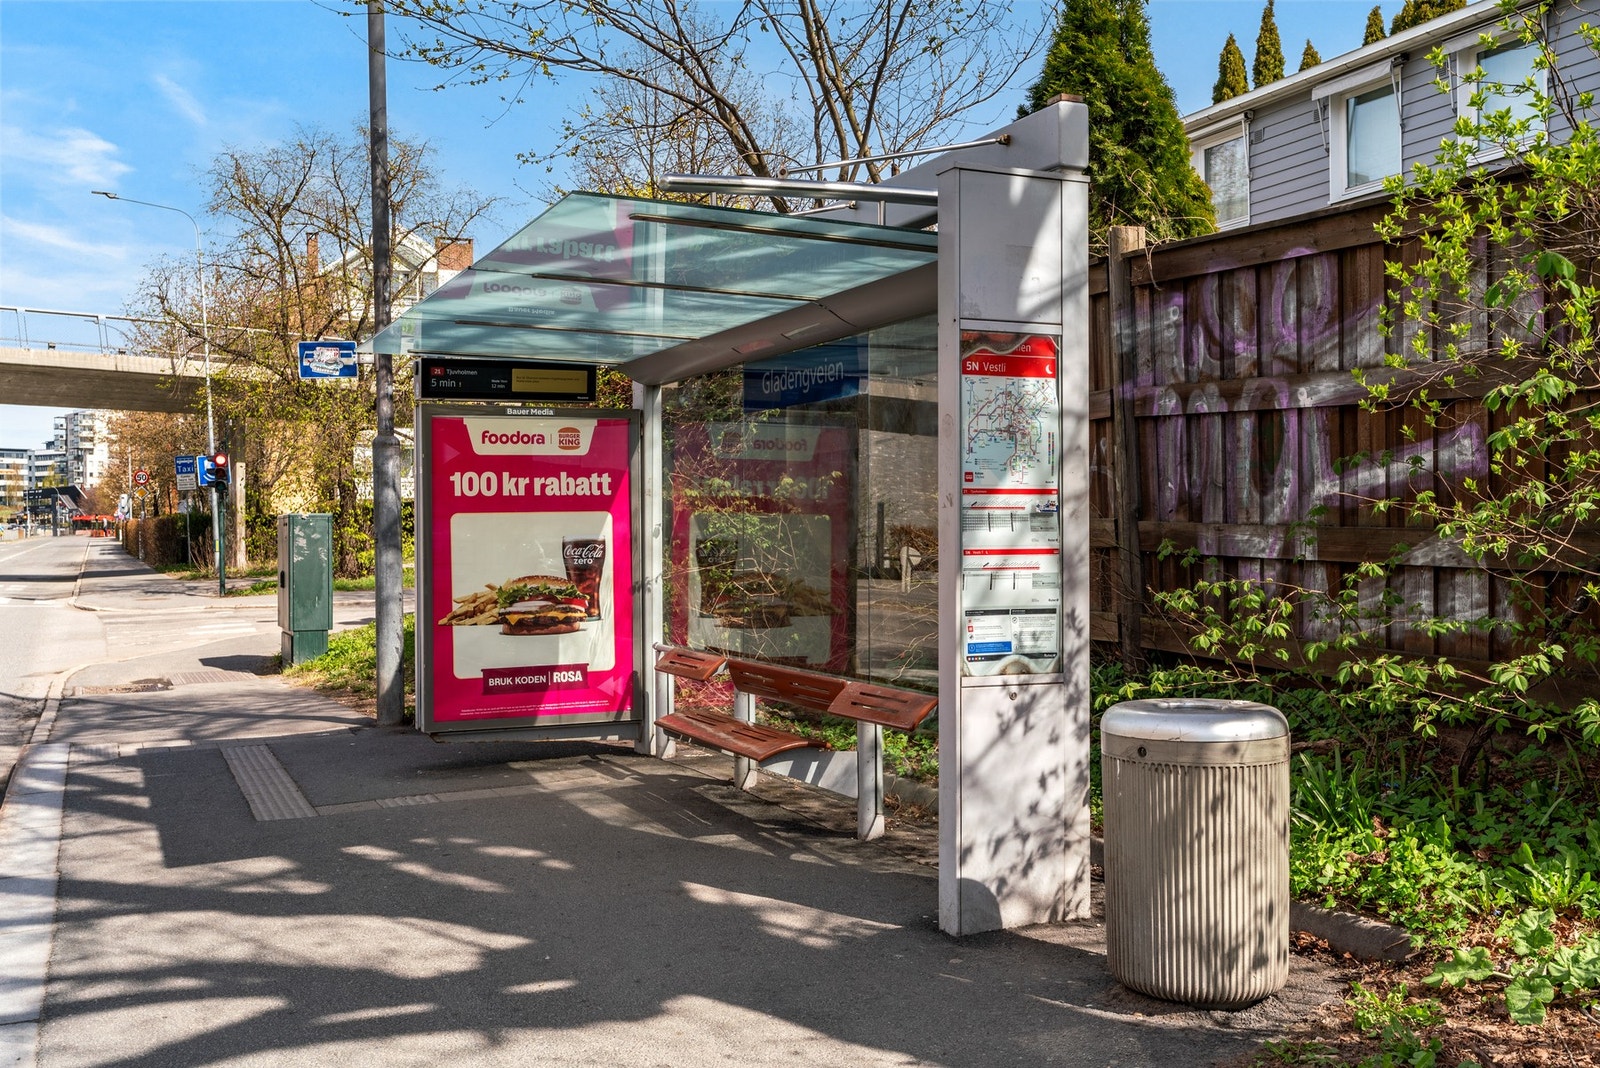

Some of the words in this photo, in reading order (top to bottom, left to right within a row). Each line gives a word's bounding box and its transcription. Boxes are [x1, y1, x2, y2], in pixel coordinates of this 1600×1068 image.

[446, 368, 478, 376] Tjuvholmen
[966, 361, 979, 371] 5N
[982, 361, 1007, 373] Vestli
[762, 358, 844, 394] Gladengveien
[431, 378, 437, 388] 5
[439, 378, 456, 388] min
[507, 408, 530, 416] Bauer
[530, 408, 554, 416] Media
[481, 430, 545, 445] foodora
[558, 438, 581, 446] KING
[450, 471, 498, 497] 100
[502, 471, 530, 497] kr
[534, 471, 612, 497] rabatt
[563, 543, 605, 559] Coca-Cola
[488, 676, 513, 687] BRUK
[515, 675, 547, 686] KODEN
[553, 671, 583, 683] ROSA
